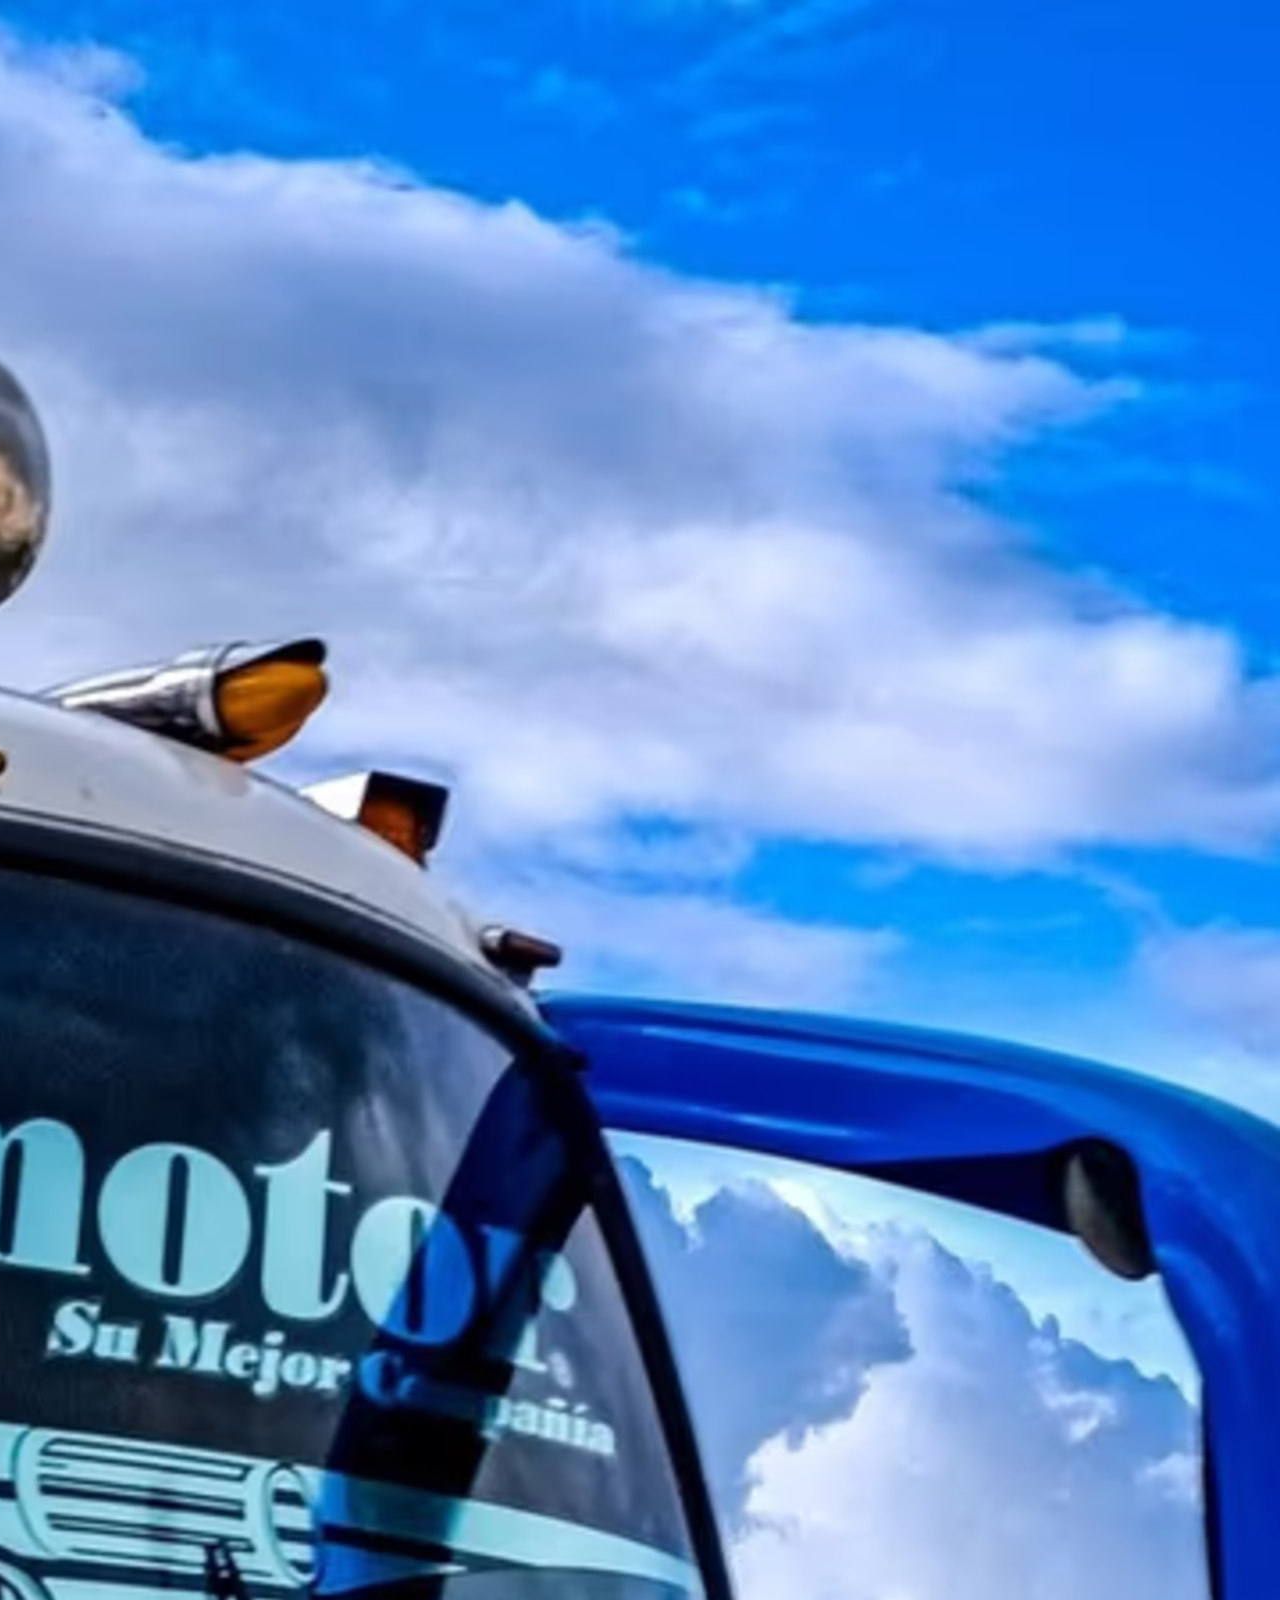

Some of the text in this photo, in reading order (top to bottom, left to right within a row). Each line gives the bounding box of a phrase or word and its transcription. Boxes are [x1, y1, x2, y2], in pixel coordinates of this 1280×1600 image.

[47, 1300, 616, 1455] Su Mejor Cpañía
